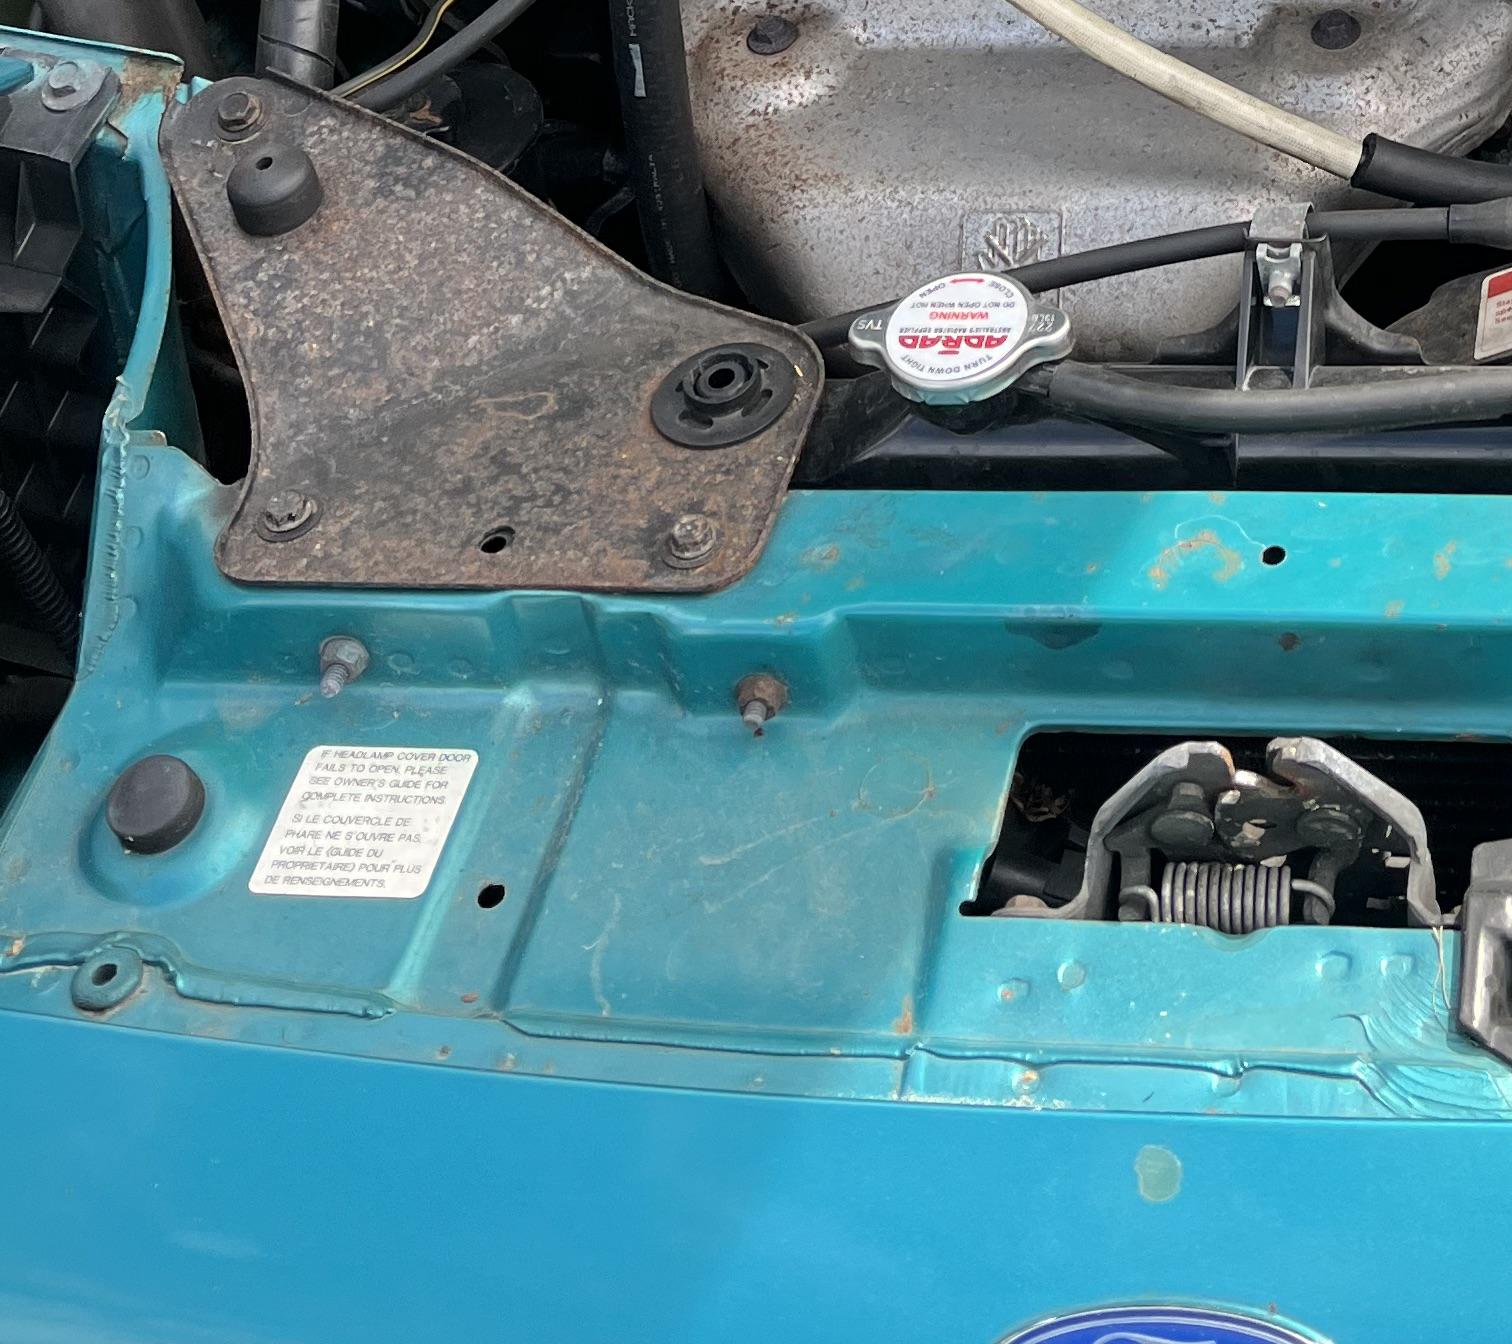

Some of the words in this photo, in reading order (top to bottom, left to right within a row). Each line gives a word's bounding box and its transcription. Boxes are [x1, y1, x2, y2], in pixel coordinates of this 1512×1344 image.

[919, 281, 946, 299] OPEN
[988, 280, 1015, 299] CLOSE
[910, 300, 929, 309] HOT
[930, 301, 956, 309] WHEN
[957, 301, 981, 309] OPEN
[983, 301, 1001, 309] NOT
[1002, 301, 1015, 309] DO
[929, 310, 989, 321] WARNING
[1495, 315, 1512, 324] See
[855, 319, 883, 331] TVS
[898, 334, 1008, 349] ADRAD
[900, 354, 926, 372] TIGHT
[963, 353, 993, 371] TURN
[928, 366, 960, 375] DOWN
[321, 750, 329, 759] IF
[335, 750, 394, 760] HEADLAMP
[398, 752, 436, 762] COVER
[438, 753, 471, 762] DOOR
[315, 764, 346, 773] FAILS
[351, 764, 365, 773] TO
[405, 766, 447, 775] PLEASE
[309, 776, 331, 785] SEE
[335, 777, 386, 787] OWNER'S
[389, 779, 421, 789] GUIDE
[424, 780, 448, 789] FOR
[301, 792, 361, 802] COMPLETE
[292, 814, 302, 823] SI
[306, 815, 319, 824] LE
[323, 815, 392, 826] COUVERCLE
[396, 817, 411, 827] DE
[285, 830, 322, 840] PHARE
[325, 831, 340, 840] NE
[345, 831, 394, 841] S'OUVRE
[279, 846, 305, 855] VOIR
[307, 847, 322, 856] LE
[326, 846, 364, 858] (GUIDE
[367, 848, 384, 858] DU
[271, 860, 356, 873] PROPRIETAIRE)
[358, 863, 390, 873] POUR
[393, 864, 421, 874] PLUS
[264, 876, 278, 885] DE
